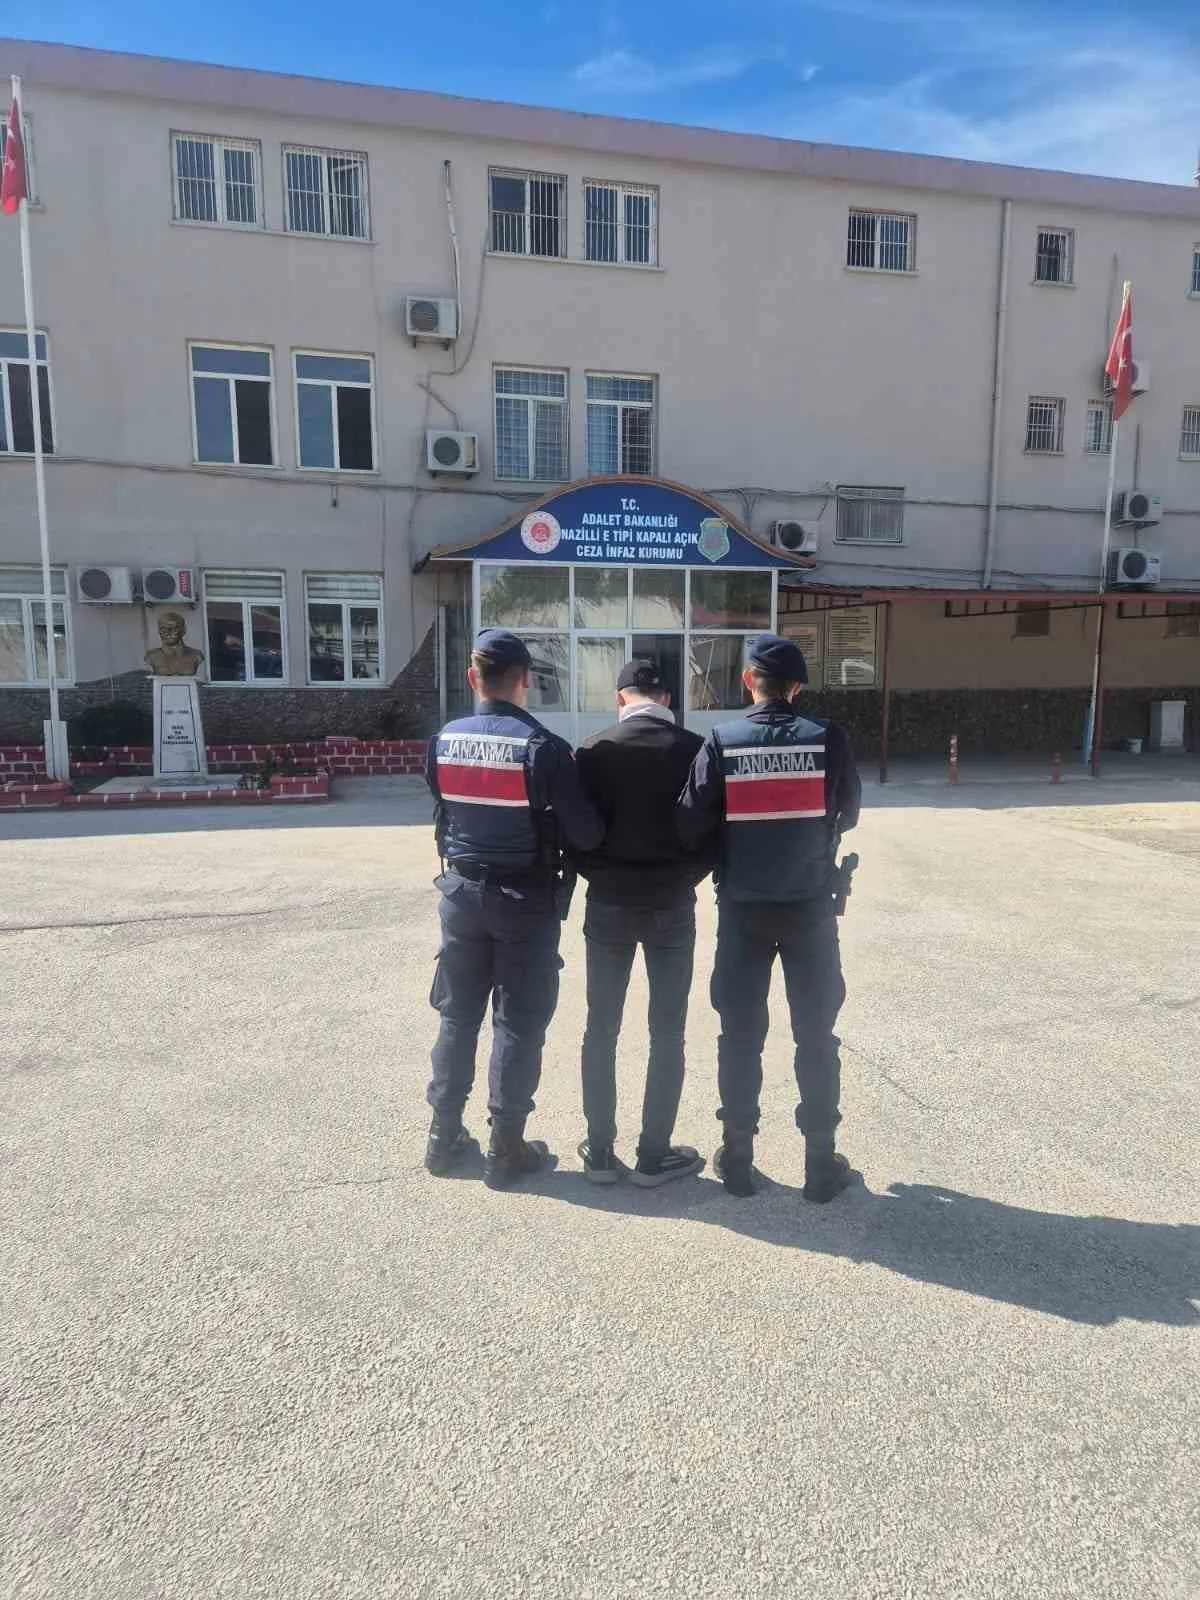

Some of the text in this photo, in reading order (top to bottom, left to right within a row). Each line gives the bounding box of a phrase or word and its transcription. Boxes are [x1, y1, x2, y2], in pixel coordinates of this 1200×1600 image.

[620, 498, 640, 511] T.C.
[582, 512, 678, 528] ADALET BAKANLIĞI
[561, 526, 600, 542] NAZİLLİ
[603, 530, 610, 542] E
[636, 531, 672, 544] KAPALI
[674, 532, 699, 547] AÇIK
[576, 543, 684, 560] CEZA İNFAZ KURUMU
[444, 738, 514, 762] JANDARMA
[734, 752, 816, 776] JANDARMA
